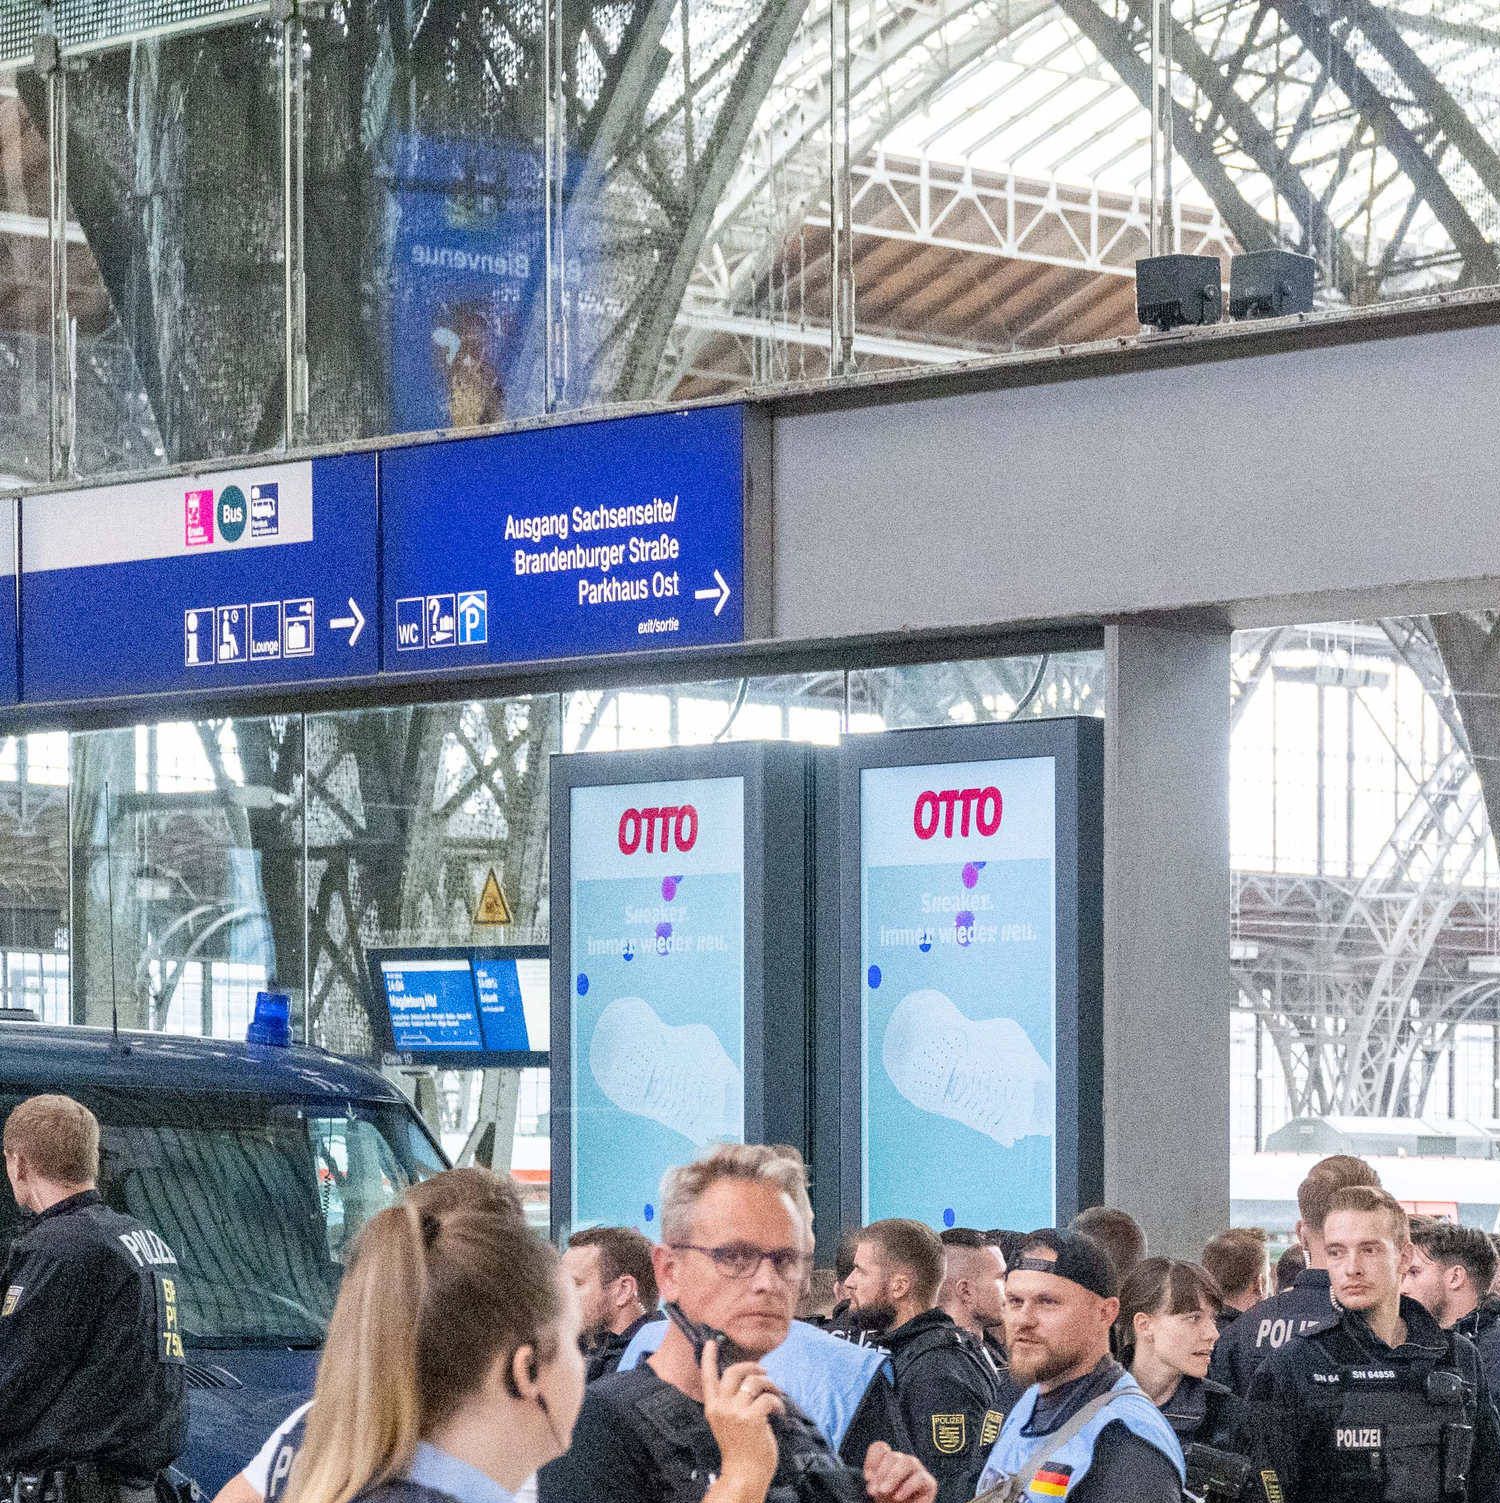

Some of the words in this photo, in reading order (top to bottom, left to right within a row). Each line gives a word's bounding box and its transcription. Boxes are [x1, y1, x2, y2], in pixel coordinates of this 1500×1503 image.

[223, 504, 242, 523] Bus
[504, 514, 568, 543] Ausgang
[572, 495, 679, 533] Sachsenseite/
[515, 543, 626, 576] Brandenburger
[629, 533, 680, 563] Straße
[578, 576, 649, 605] Parkhaus
[652, 571, 680, 598] Ost
[398, 624, 419, 644] WC
[637, 616, 680, 634] exit/sortie
[252, 639, 279, 654] Lounge
[913, 785, 1003, 841] OTTO
[617, 804, 699, 856] OTTO
[1337, 1429, 1381, 1447] POLIZEI
